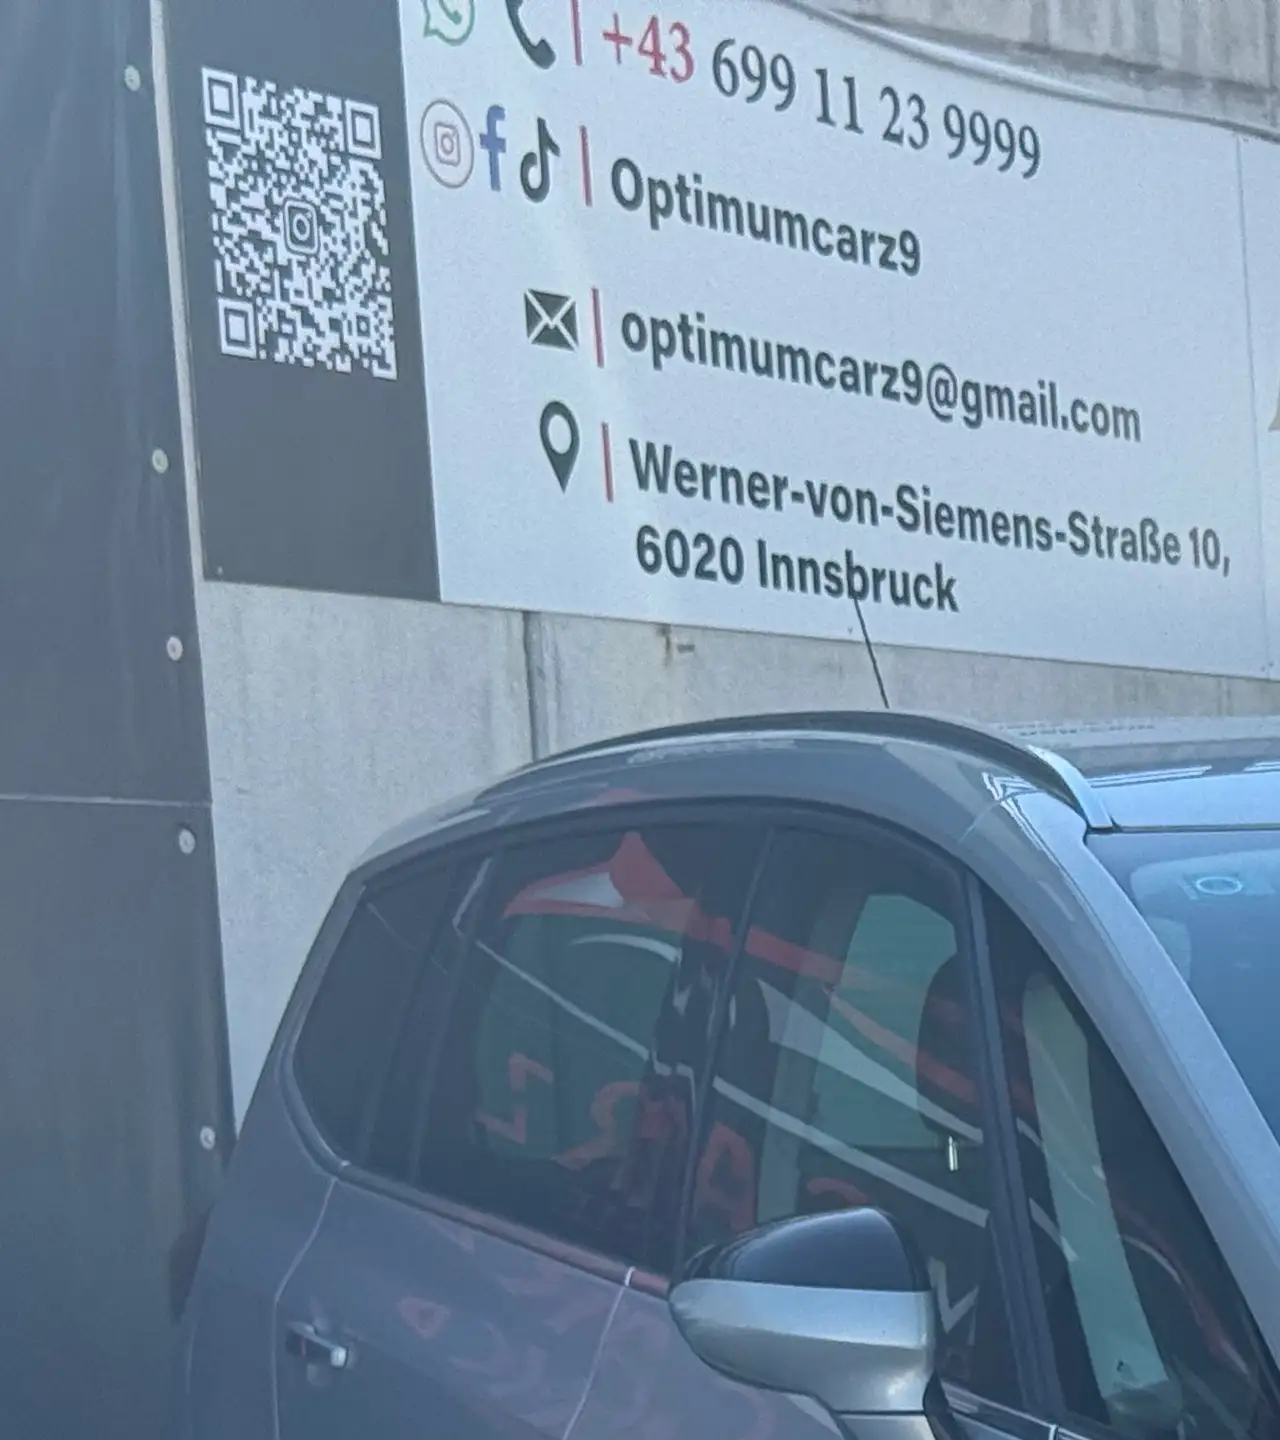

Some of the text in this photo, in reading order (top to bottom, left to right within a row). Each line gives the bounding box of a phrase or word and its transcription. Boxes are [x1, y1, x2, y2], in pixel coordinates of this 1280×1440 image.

[602, 13, 1042, 180] +43 699 11 23 9999
[610, 157, 922, 277] Optimumcarz9
[620, 310, 1142, 442] optimumcarz9@gmail.com
[628, 437, 1231, 577] Werner-von-Siemens-Straße 10,
[635, 524, 960, 612] 6020 Innsbruck
